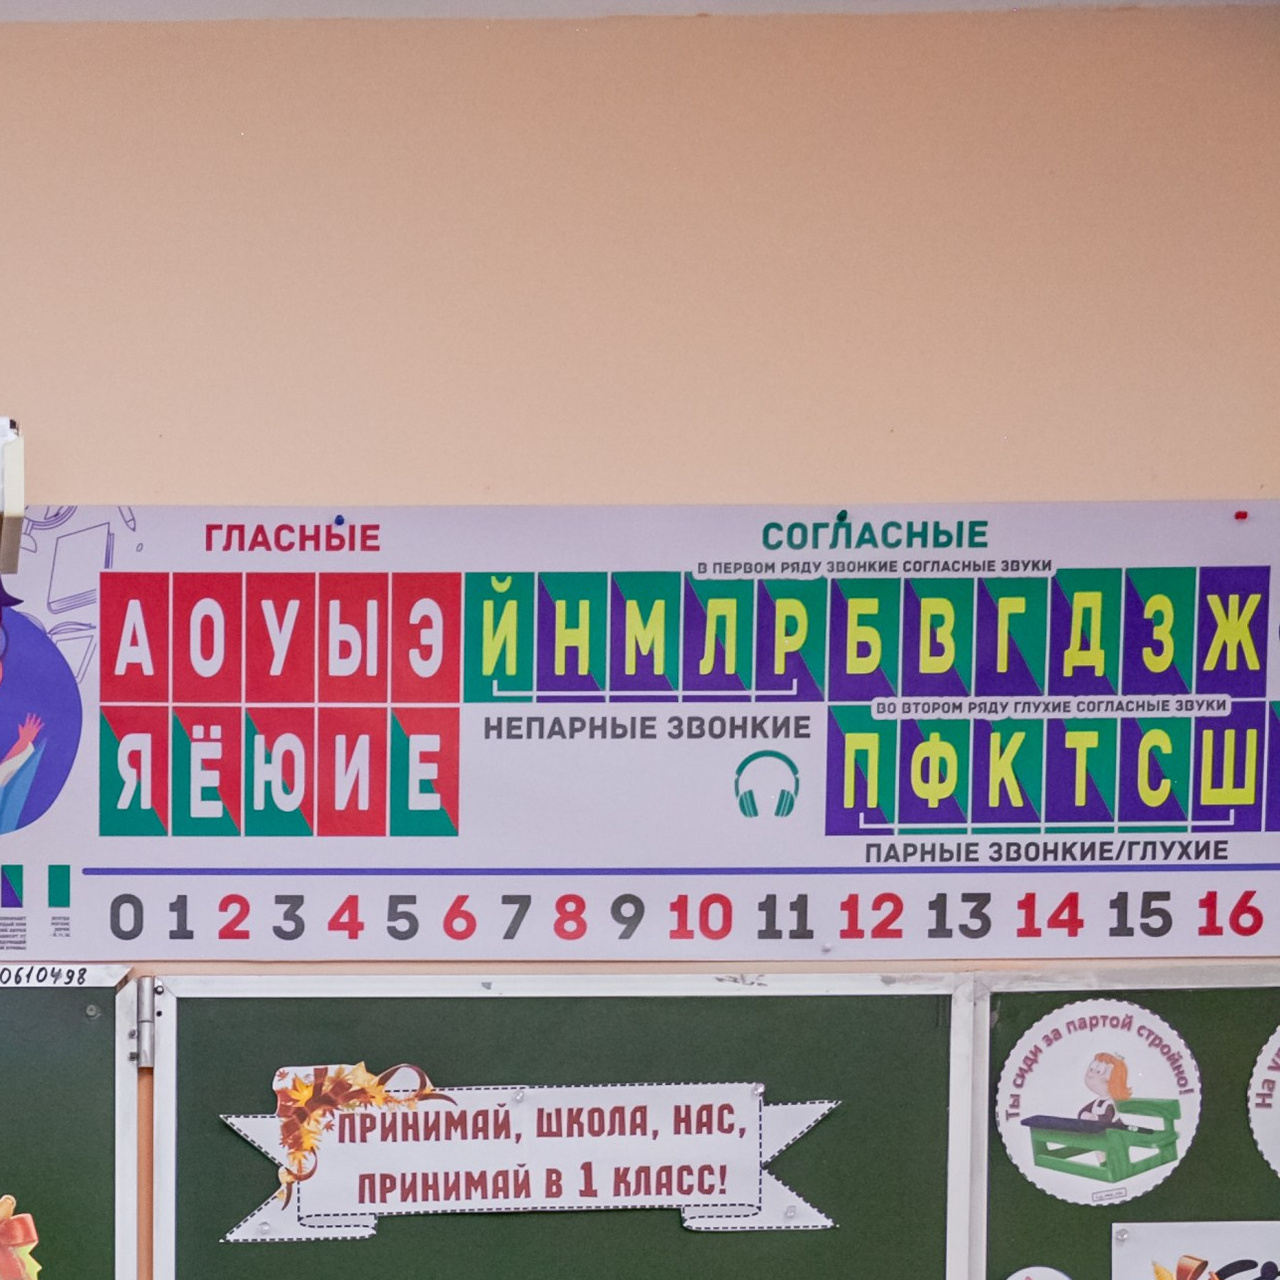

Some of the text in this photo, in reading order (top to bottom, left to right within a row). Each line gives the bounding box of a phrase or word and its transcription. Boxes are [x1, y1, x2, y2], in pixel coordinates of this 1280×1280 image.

[205, 523, 381, 552] ГЛАСНЫЕ
[762, 519, 989, 550] СОГЛАСНЫЕ
[697, 559, 1052, 575] В ПЕРВОМ РЯДУ ЗВОНКИЕ СОГЛАСНЫЕ ЗВУКИ
[116, 598, 443, 678] А О У Ы Э
[483, 575, 1261, 678] Й Н М Л Р Б В Г Д З Ж
[484, 715, 812, 740] НЕПАРНЫЕ ЗВОНКИЕ
[876, 699, 1227, 716] ВО ВТОРОМ РЯДУ ГЛУХИЕ СОГЛАСНЫЕ ЗВУКИ
[117, 725, 442, 818] Я Ё Ю И Е
[843, 728, 1258, 808] П Ф К Т С Ш
[865, 839, 1230, 864] ПАРНЫЕ ЗВОНКИЕ/ГЛУХИЕ
[110, 893, 144, 941] 0
[168, 894, 194, 940] 1
[218, 893, 251, 940] 2
[272, 894, 305, 941] 3
[327, 894, 365, 940] 4
[386, 894, 419, 941] 5
[442, 894, 477, 941] 6
[501, 894, 532, 940] 7
[553, 893, 588, 941] 8
[610, 893, 645, 940] 9
[669, 892, 733, 941] 10
[757, 893, 814, 940] 11
[839, 892, 904, 940] 12
[927, 892, 992, 940] 13
[1016, 891, 1085, 938] 14
[1108, 890, 1173, 938] 15
[1197, 890, 1264, 937] 16
[1005, 1013, 1195, 1121] Ты сиди за партой стройно!
[338, 1102, 747, 1144] ПРИНИМАЙ, ШКОЛА, НАС,
[358, 1161, 727, 1204] ПРИНИМАЙ В 1 КЛАСС!
